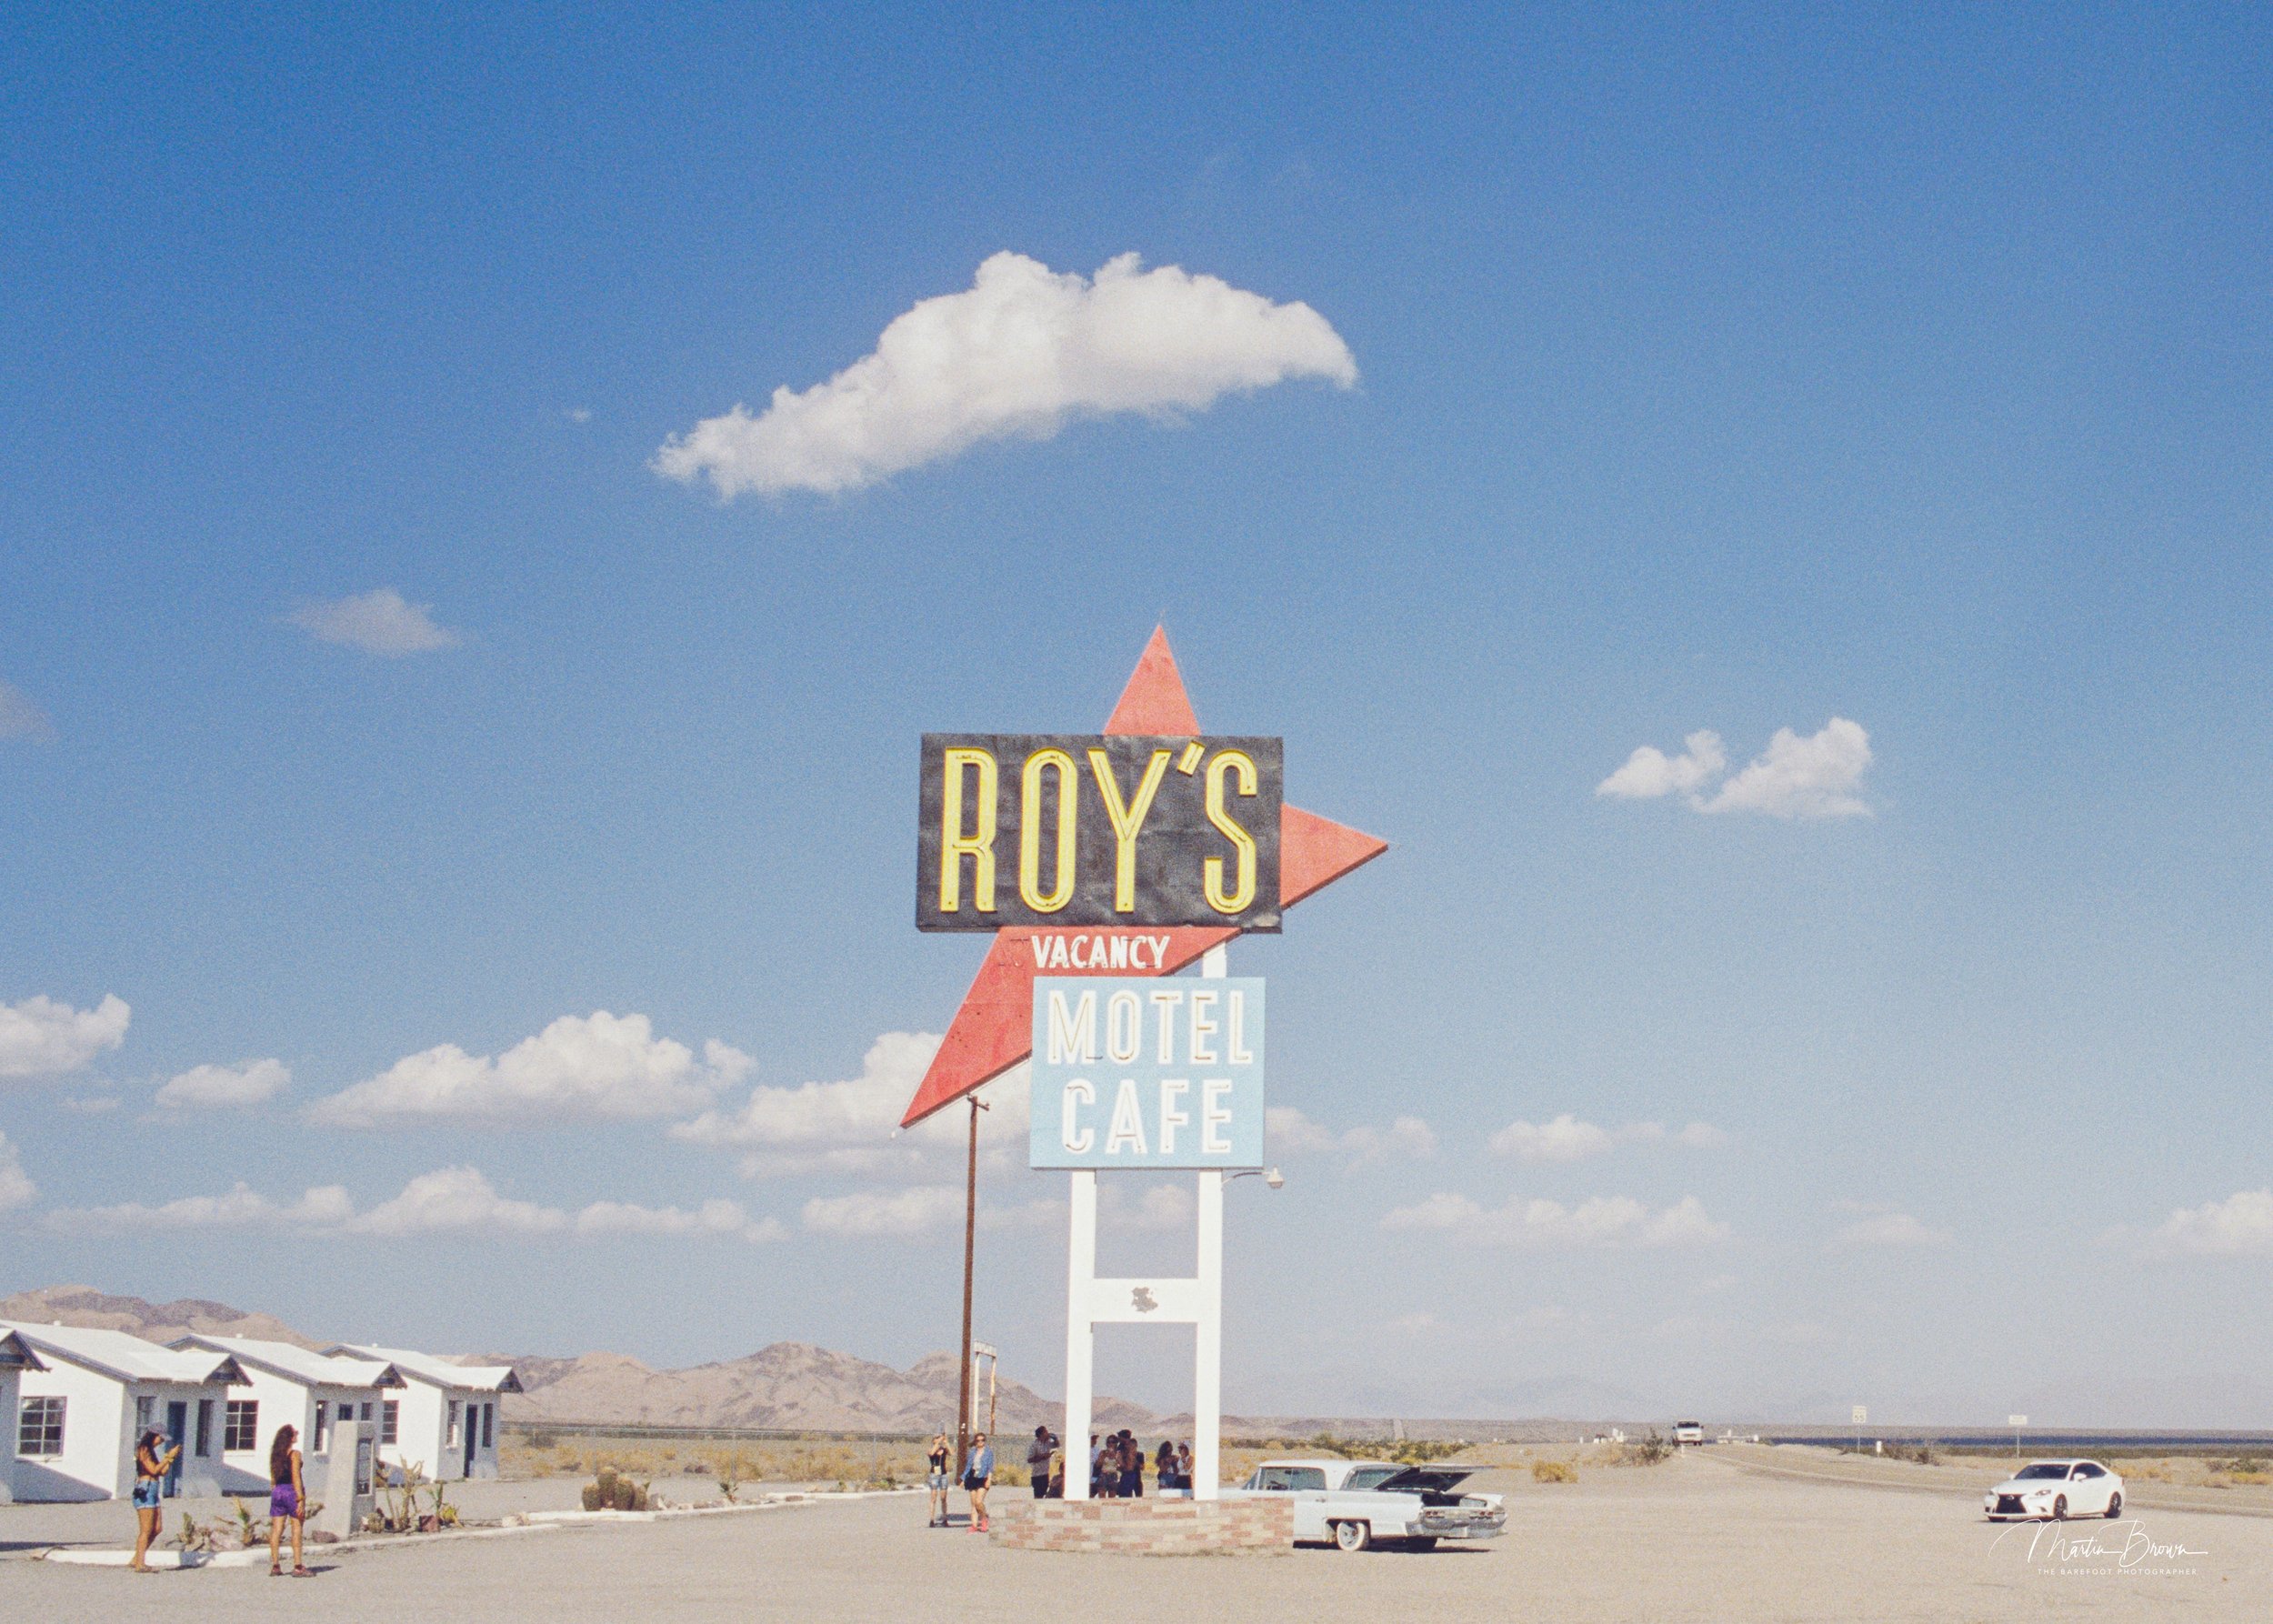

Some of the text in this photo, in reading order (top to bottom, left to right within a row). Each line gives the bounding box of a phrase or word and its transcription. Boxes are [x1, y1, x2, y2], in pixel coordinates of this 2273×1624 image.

[940, 741, 1258, 914] ROY'S
[1031, 935, 1171, 969] VACANCY
[1047, 989, 1254, 1066] MOTEL
[1062, 1078, 1233, 1155] CAFE
